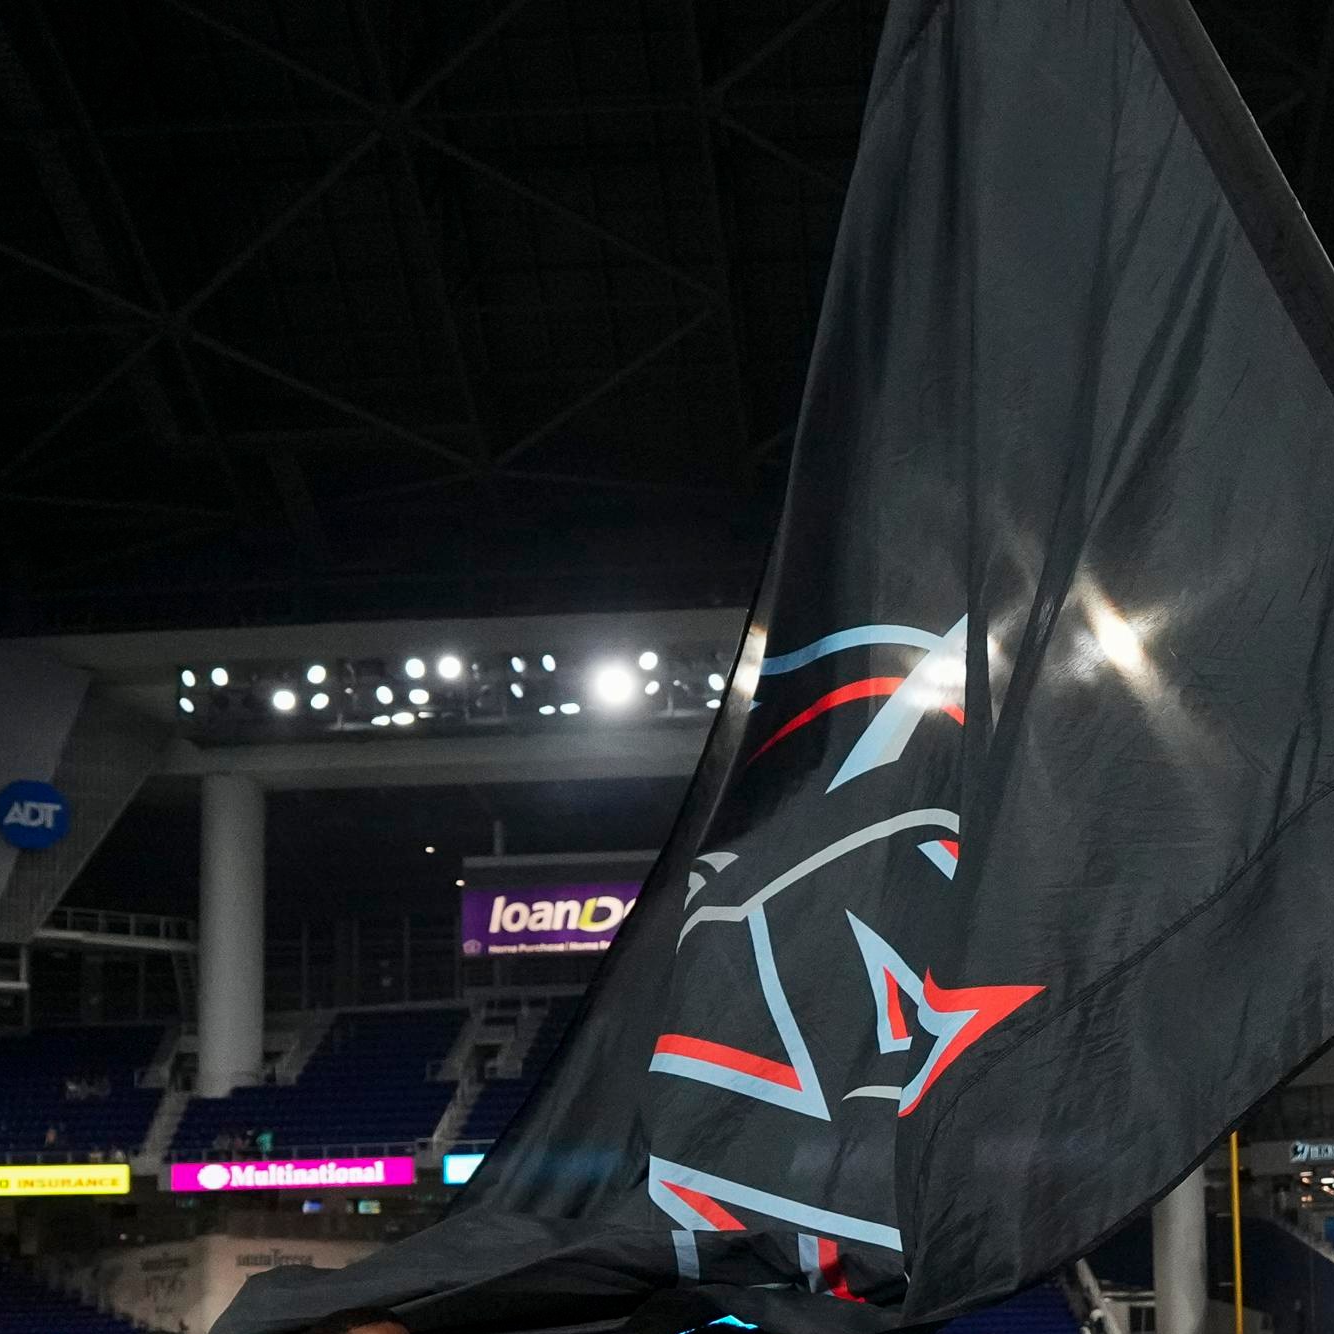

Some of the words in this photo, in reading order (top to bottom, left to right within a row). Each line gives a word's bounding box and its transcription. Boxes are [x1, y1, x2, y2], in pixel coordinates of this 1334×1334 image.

[3, 801, 61, 828] ADT
[18, 1177, 120, 1188] INSURANCE
[229, 1161, 385, 1186] Multinational
